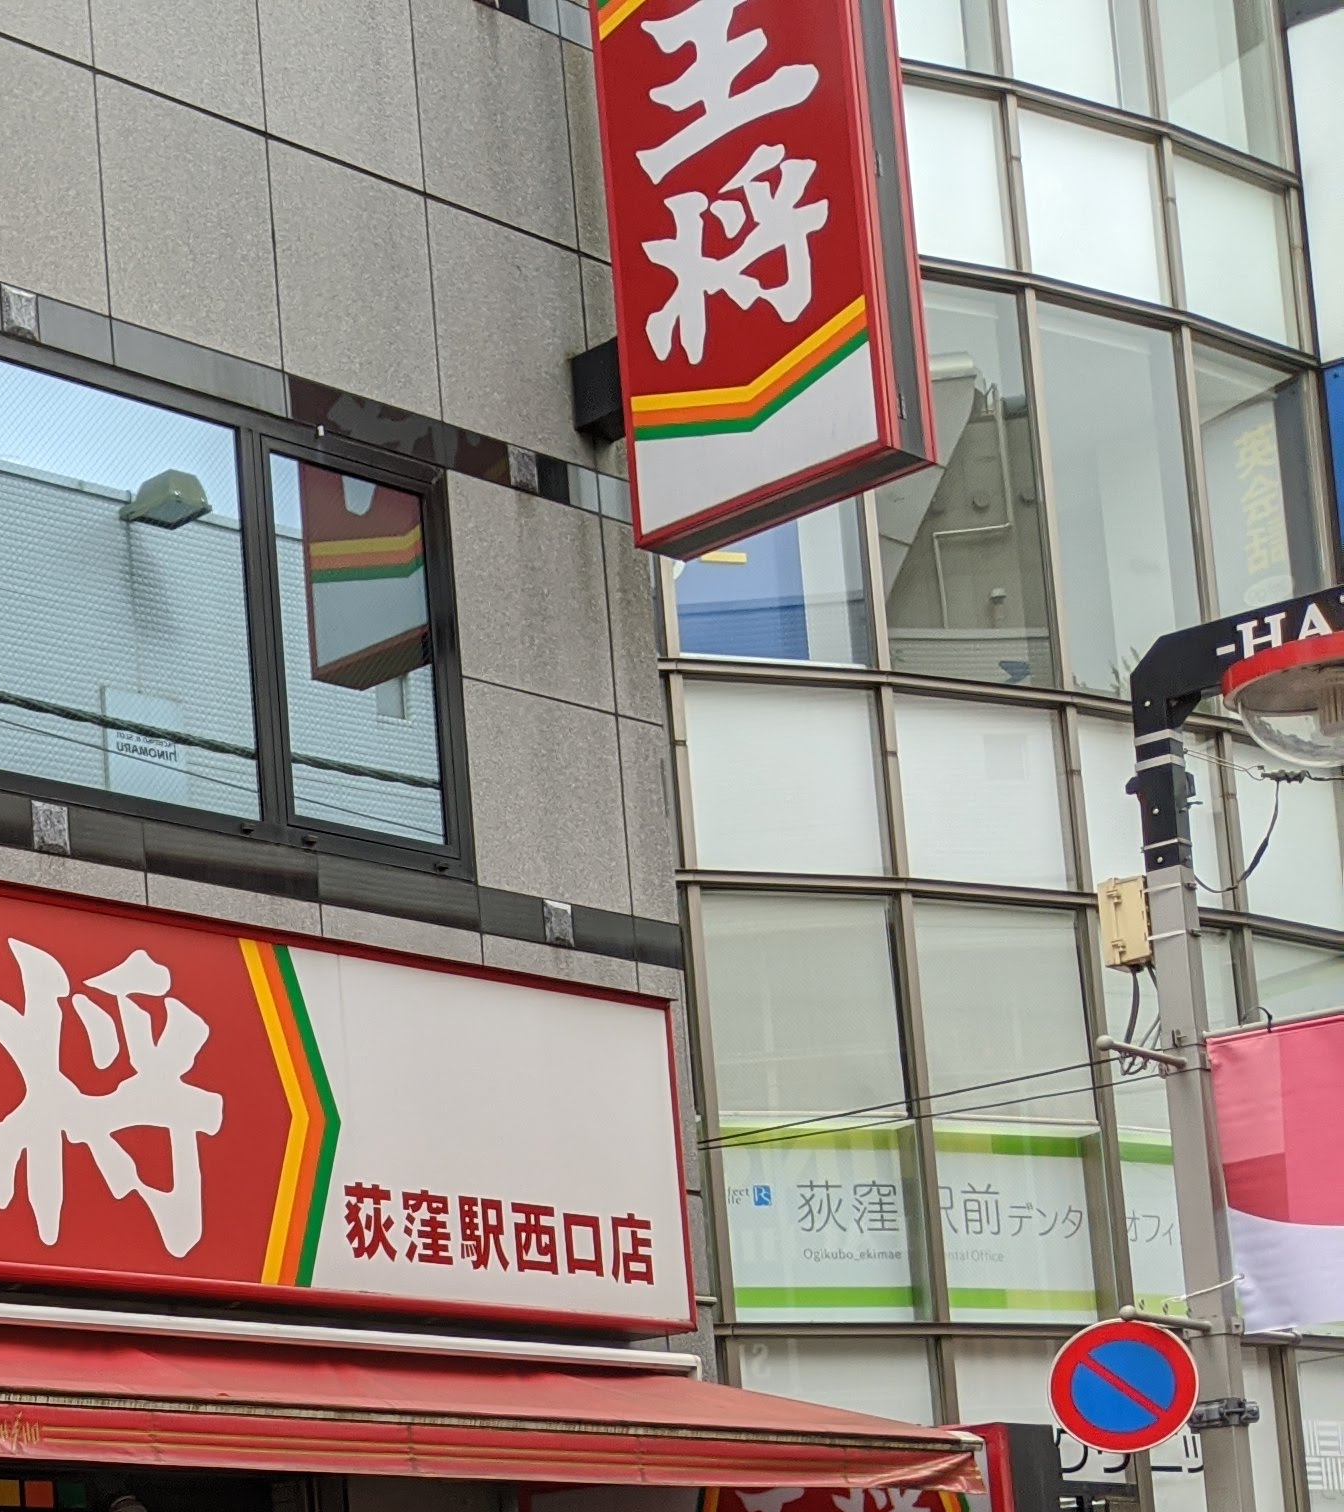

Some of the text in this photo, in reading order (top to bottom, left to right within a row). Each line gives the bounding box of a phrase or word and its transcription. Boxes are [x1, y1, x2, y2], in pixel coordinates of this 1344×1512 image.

[636, 0, 828, 364] 王将
[343, 1181, 655, 1285] 荻窪駅西口店
